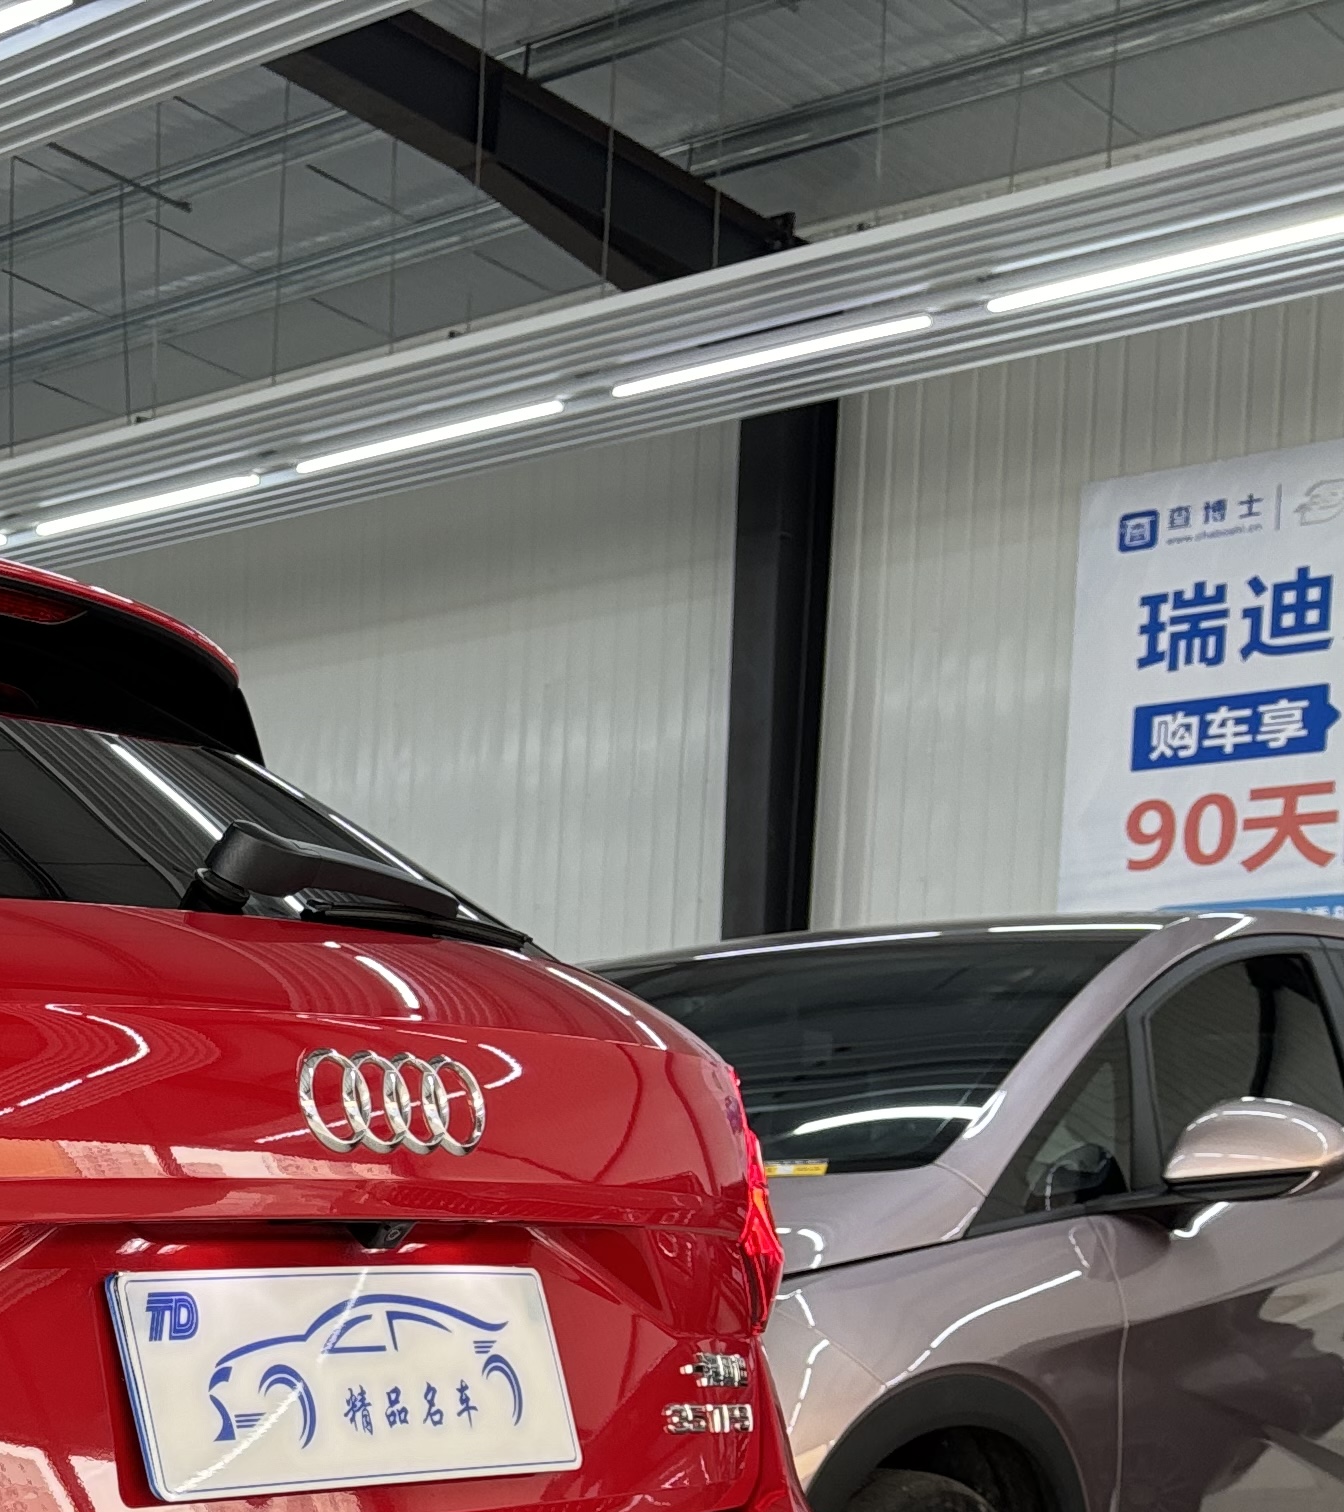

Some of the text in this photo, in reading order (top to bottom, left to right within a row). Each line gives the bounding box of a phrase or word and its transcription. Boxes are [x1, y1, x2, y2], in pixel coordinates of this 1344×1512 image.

[1137, 565, 1334, 672] 瑞迪
[1149, 698, 1310, 761] 购车享
[1126, 780, 1339, 872] 90天
[145, 1291, 200, 1342] TD
